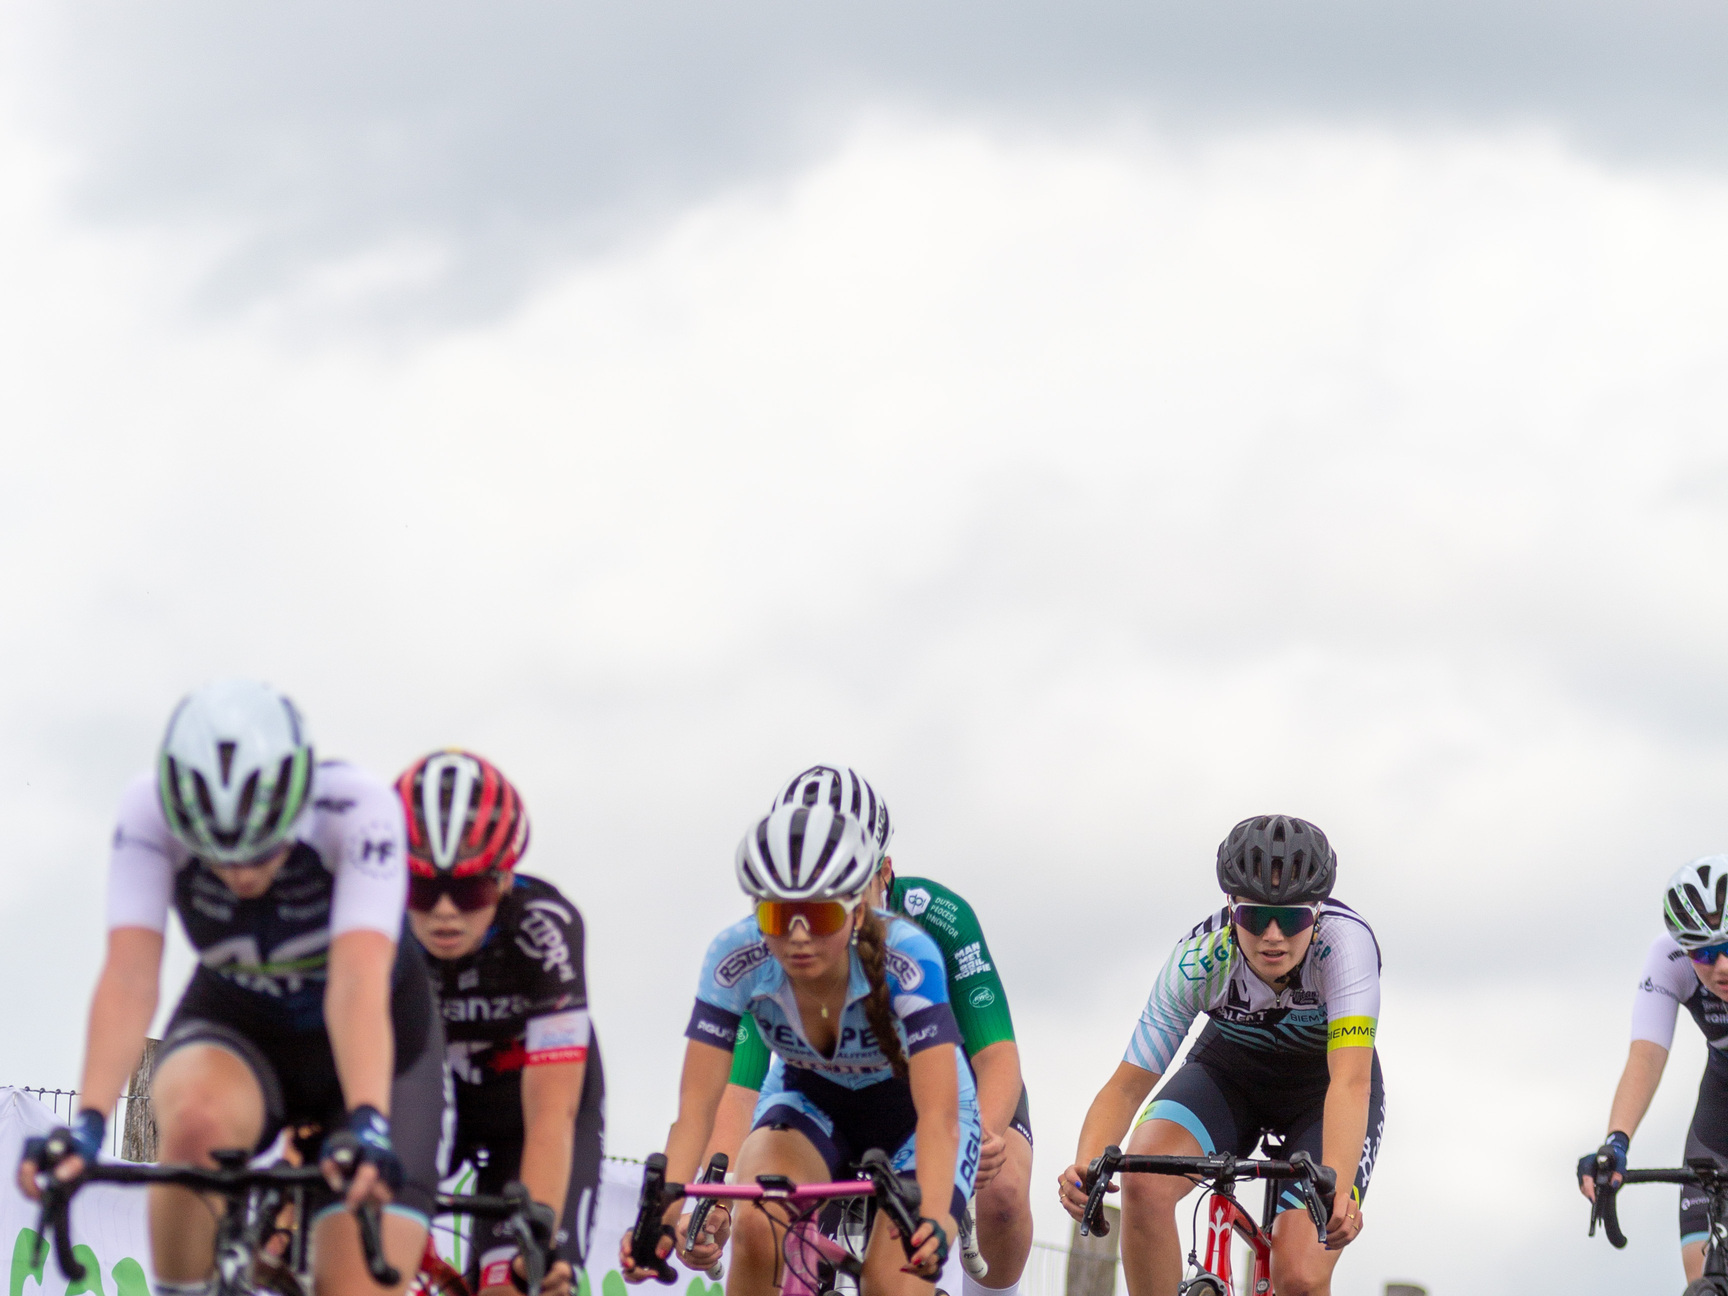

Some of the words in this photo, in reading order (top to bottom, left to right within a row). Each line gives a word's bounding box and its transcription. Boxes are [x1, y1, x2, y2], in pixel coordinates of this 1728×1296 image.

[934, 897, 959, 913] DUTCH
[954, 941, 981, 960] MAN
[958, 950, 981, 965] MET
[1290, 1009, 1328, 1023] BIEMM
